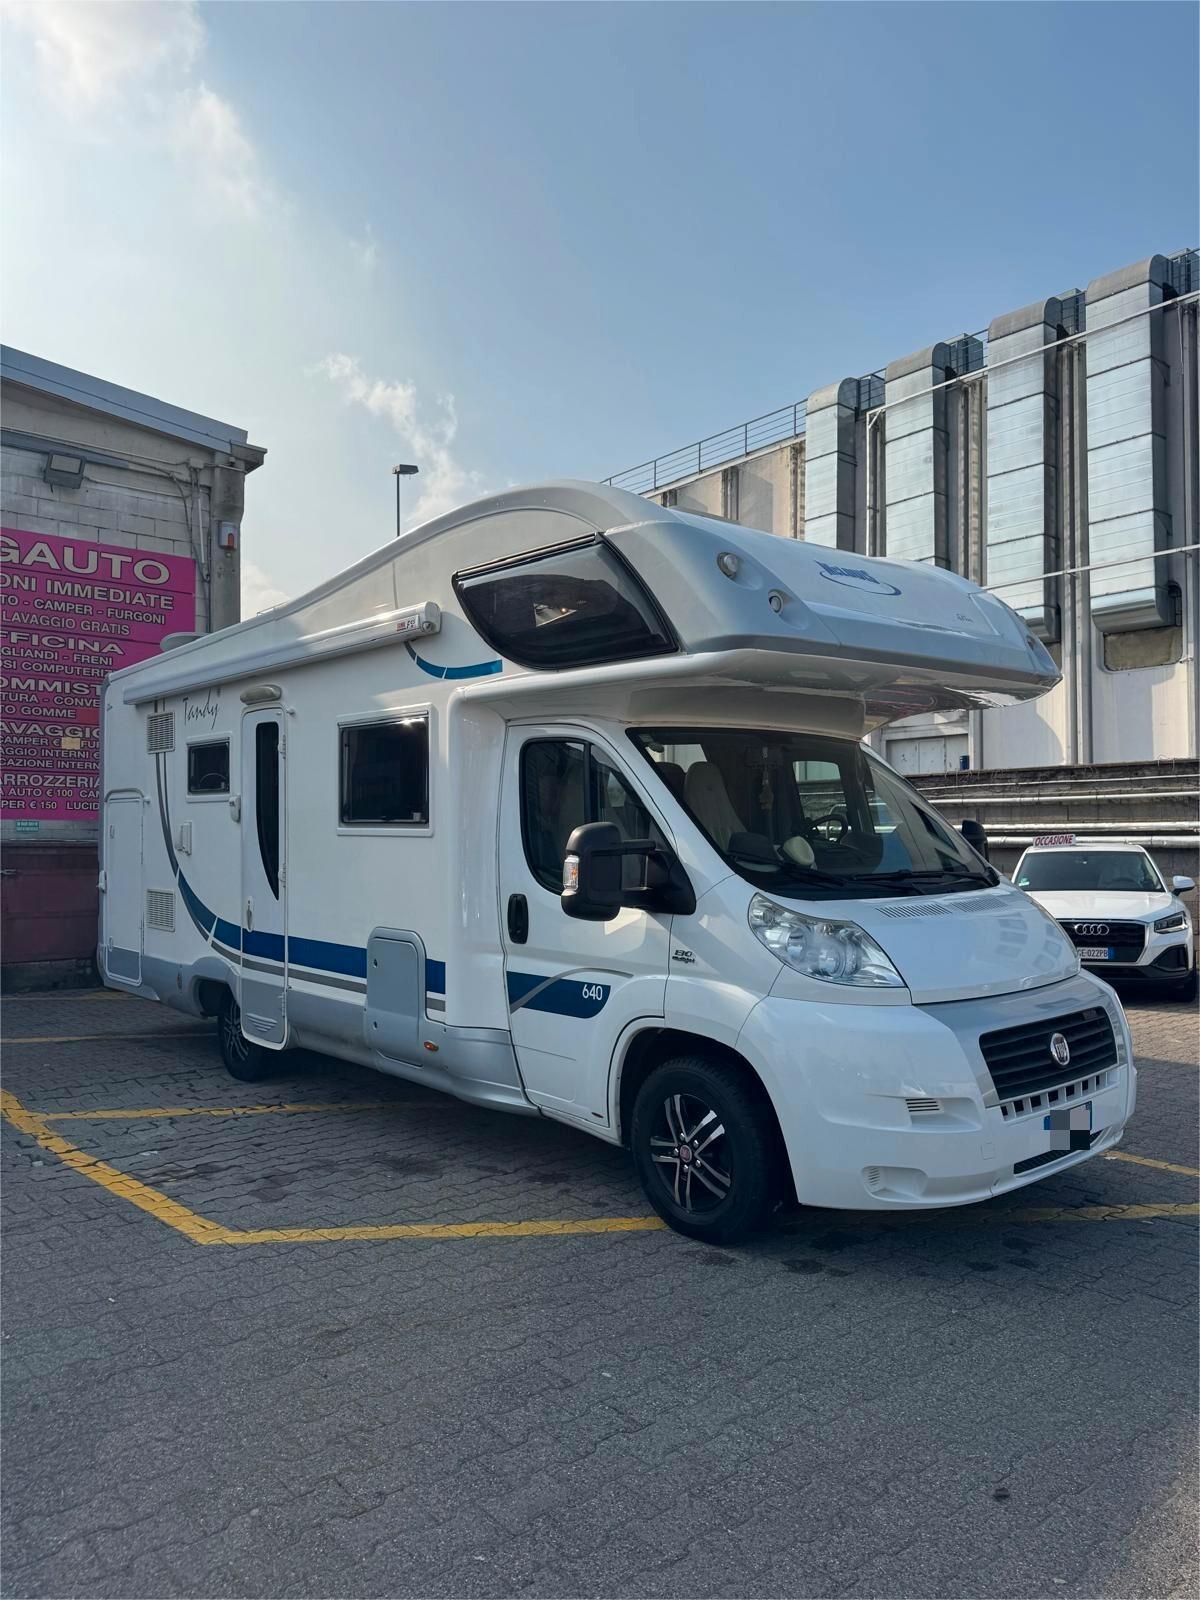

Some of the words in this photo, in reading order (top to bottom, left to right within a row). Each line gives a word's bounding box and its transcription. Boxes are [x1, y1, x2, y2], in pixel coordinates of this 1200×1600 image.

[46, 579, 174, 610] IMMEDIATE
[34, 598, 93, 615] CAMPER
[107, 608, 165, 625] FURGONI
[2, 610, 76, 630] LAVAGGIO
[80, 620, 130, 635] GRATIS
[73, 653, 113, 666] FRENI
[0, 691, 38, 703] TURA
[53, 696, 100, 708] CONVE
[21, 706, 76, 718] GOMME
[0, 736, 49, 747] AMPER
[41, 749, 89, 759] INTERNI
[57, 760, 100, 770] INTERN
[8, 788, 42, 797] AUTO
[57, 789, 73, 797] 100
[41, 801, 57, 809] 150
[1034, 835, 1074, 847] OCCASIONE
[582, 983, 603, 1001] 640
